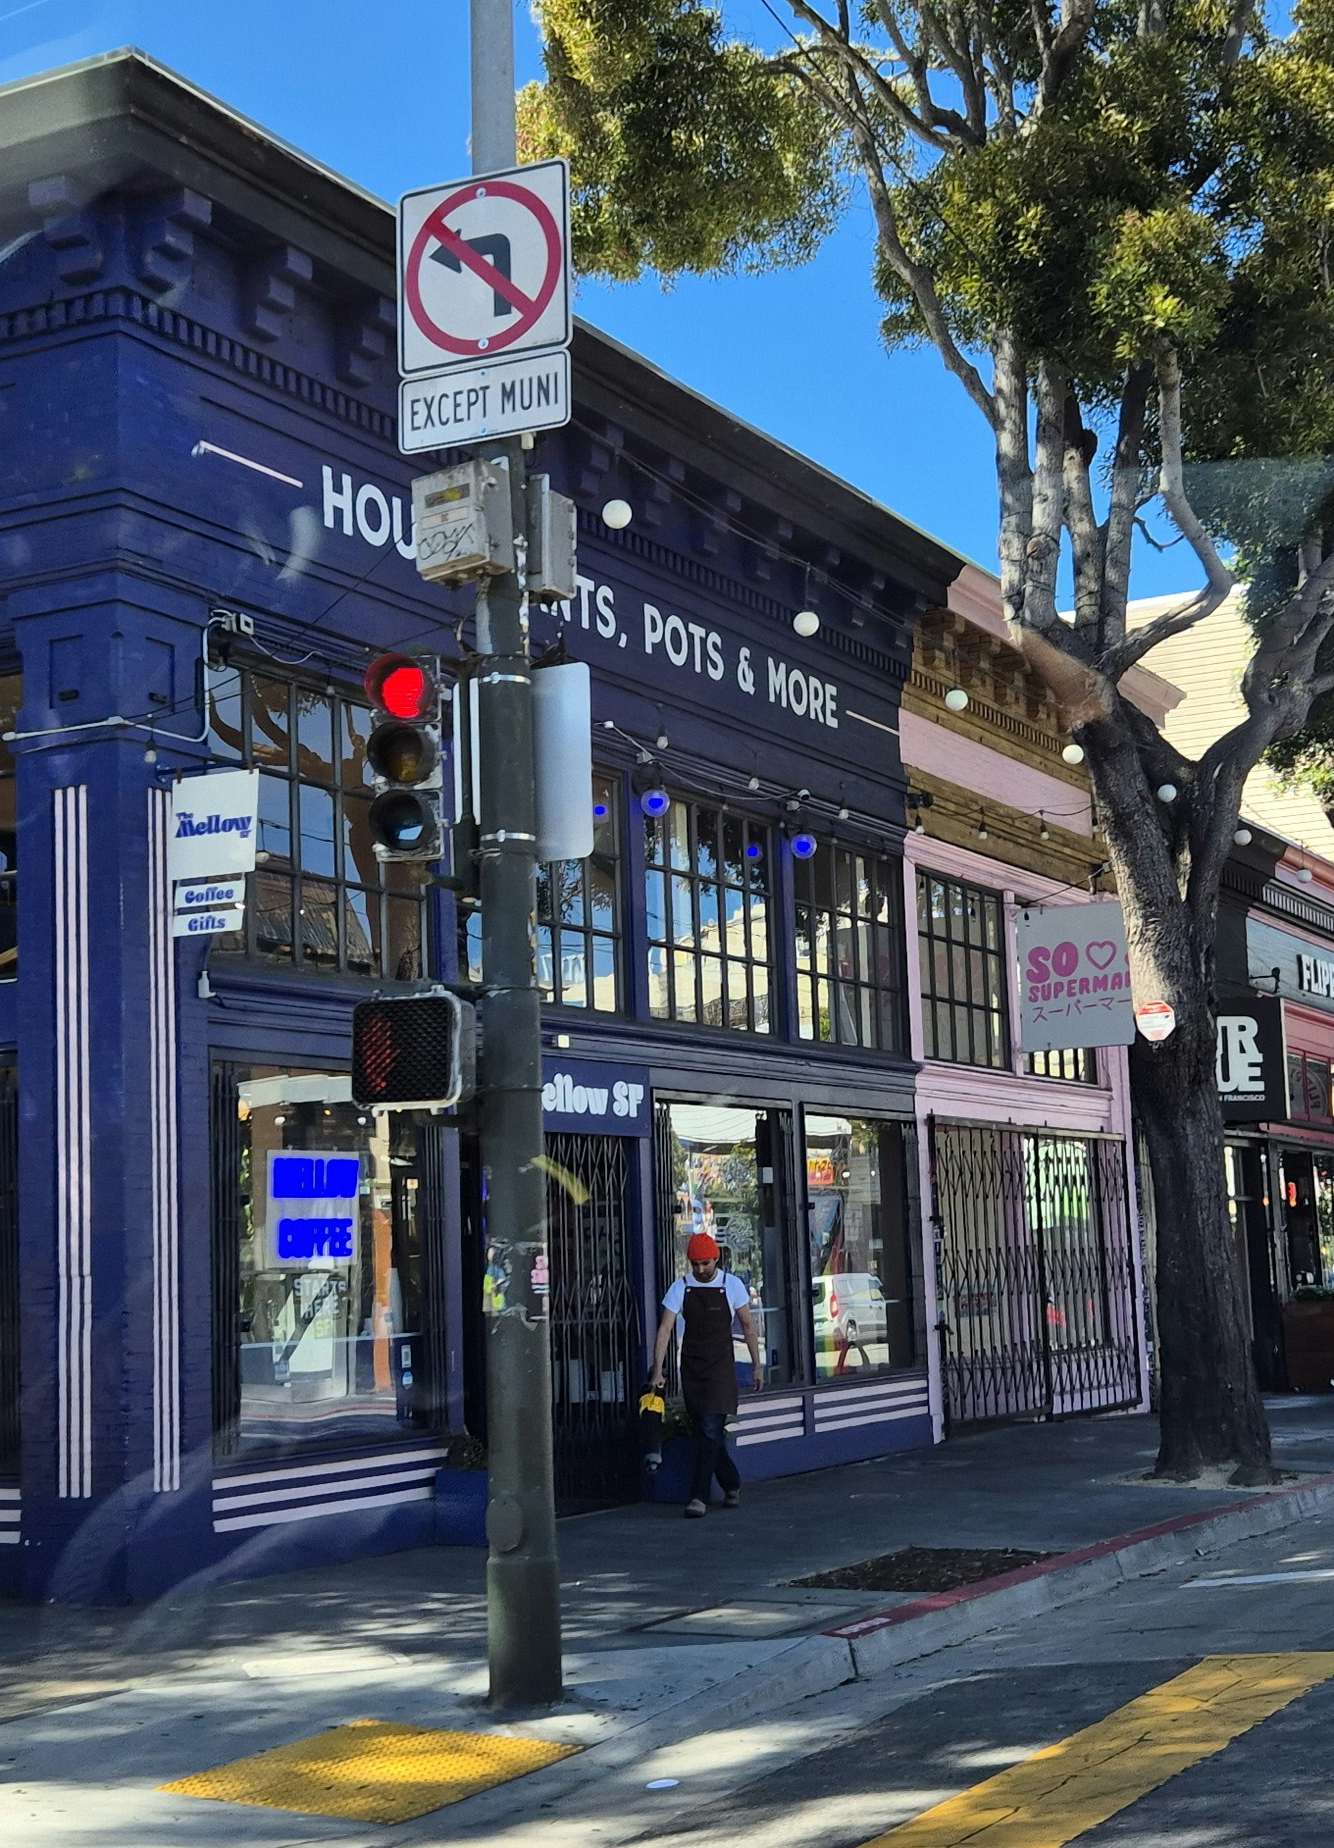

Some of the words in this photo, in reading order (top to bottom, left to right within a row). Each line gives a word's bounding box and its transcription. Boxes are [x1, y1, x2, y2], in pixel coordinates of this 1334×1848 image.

[411, 385, 490, 431] EXCEPT
[501, 371, 558, 415] MUNI
[644, 603, 724, 681] POTS
[737, 647, 755, 696] &
[768, 656, 838, 729] MORE
[175, 814, 252, 838] Mellow
[185, 887, 234, 904] Coffee
[188, 915, 226, 932] Gifts
[1026, 941, 1079, 984] SO
[541, 1073, 609, 1116] ellow
[613, 1081, 644, 1118] SF
